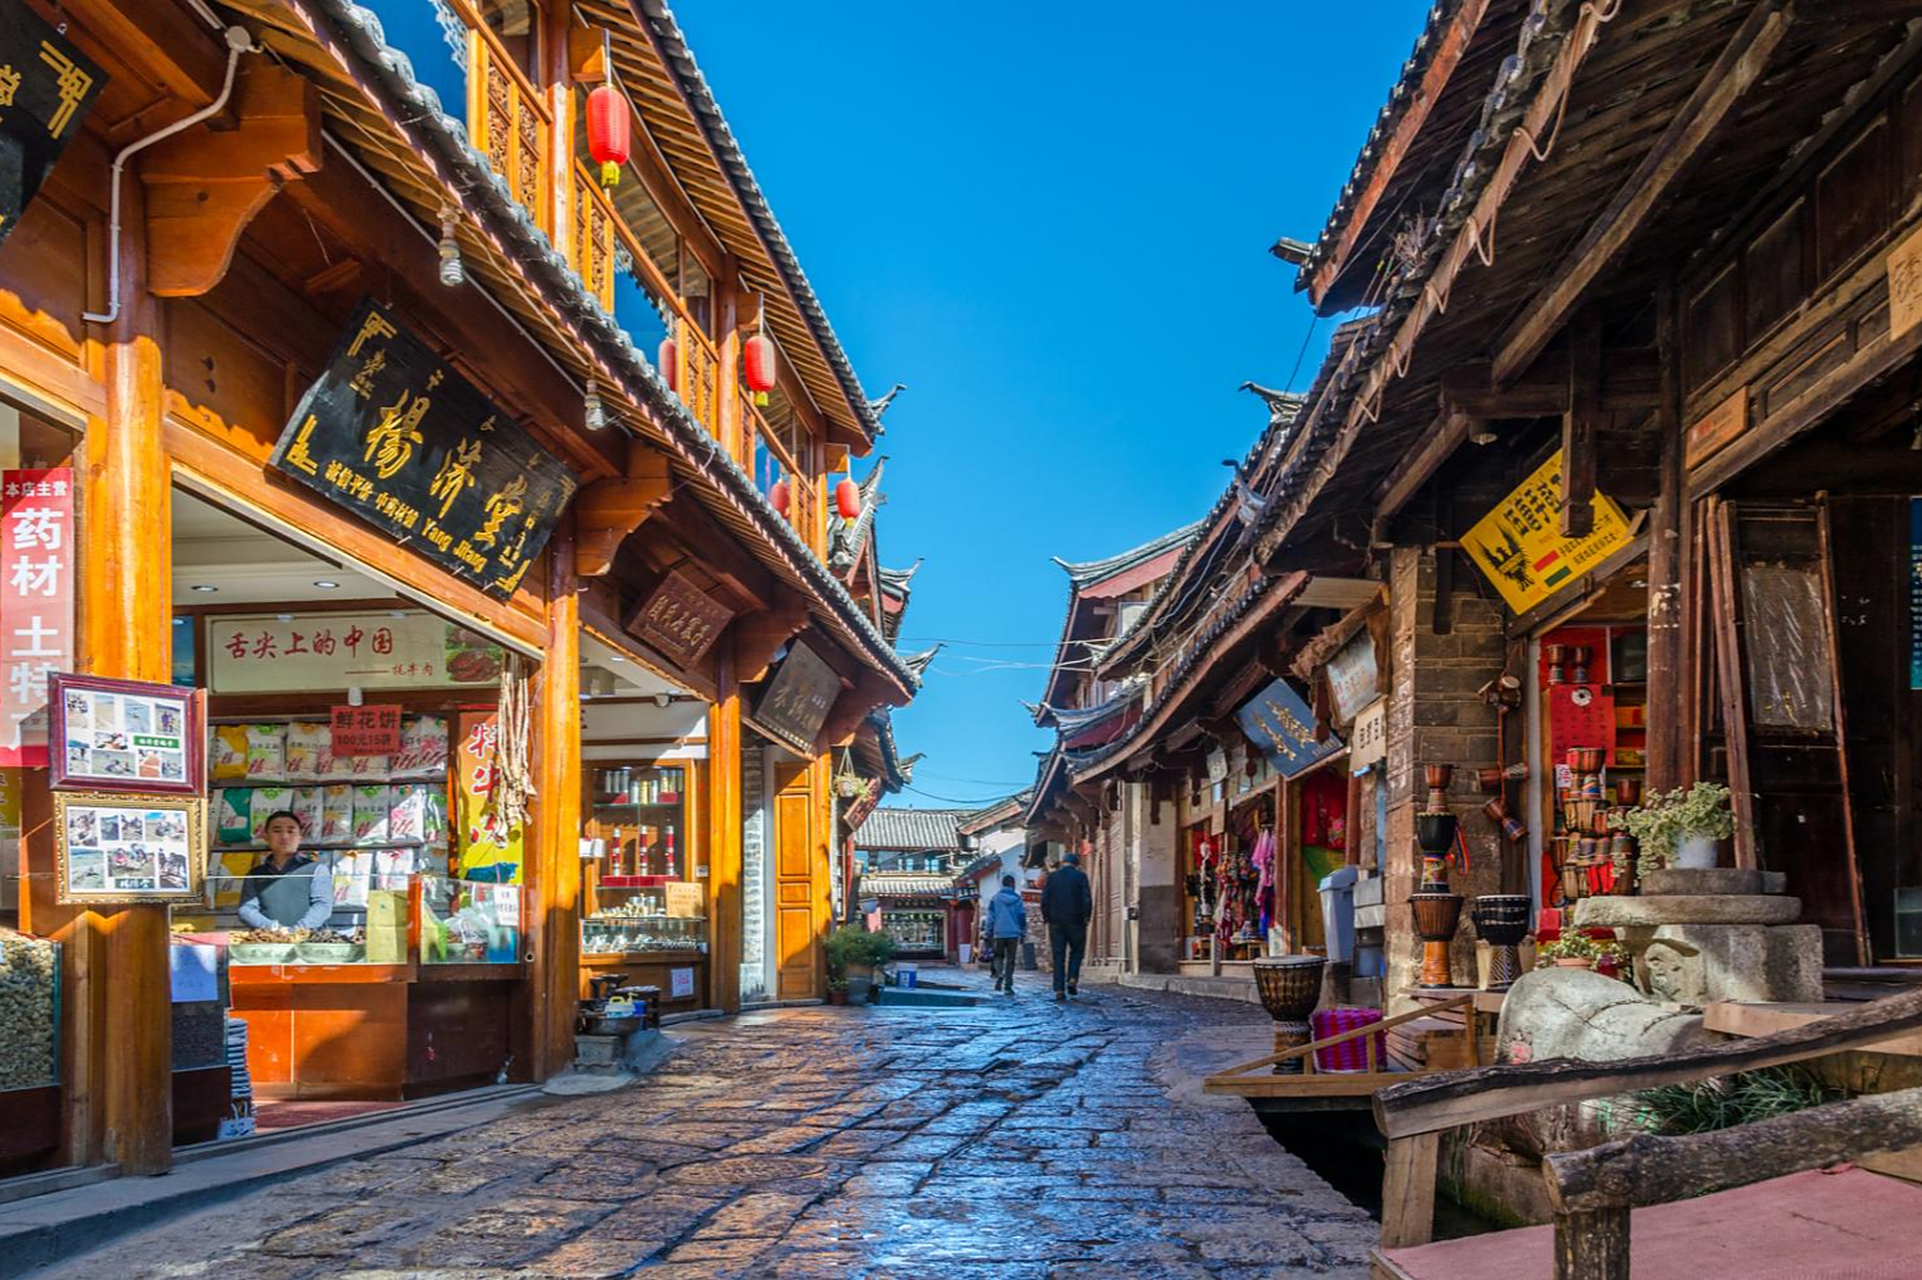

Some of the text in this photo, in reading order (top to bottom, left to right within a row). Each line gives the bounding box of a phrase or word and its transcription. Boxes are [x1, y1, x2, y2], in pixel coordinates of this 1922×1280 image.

[5, 480, 67, 497] 本店主营
[421, 517, 453, 552] Yang
[453, 540, 488, 573] Jitang
[225, 625, 394, 659] 舌尖上的中国
[336, 710, 397, 729] 鲜花饼
